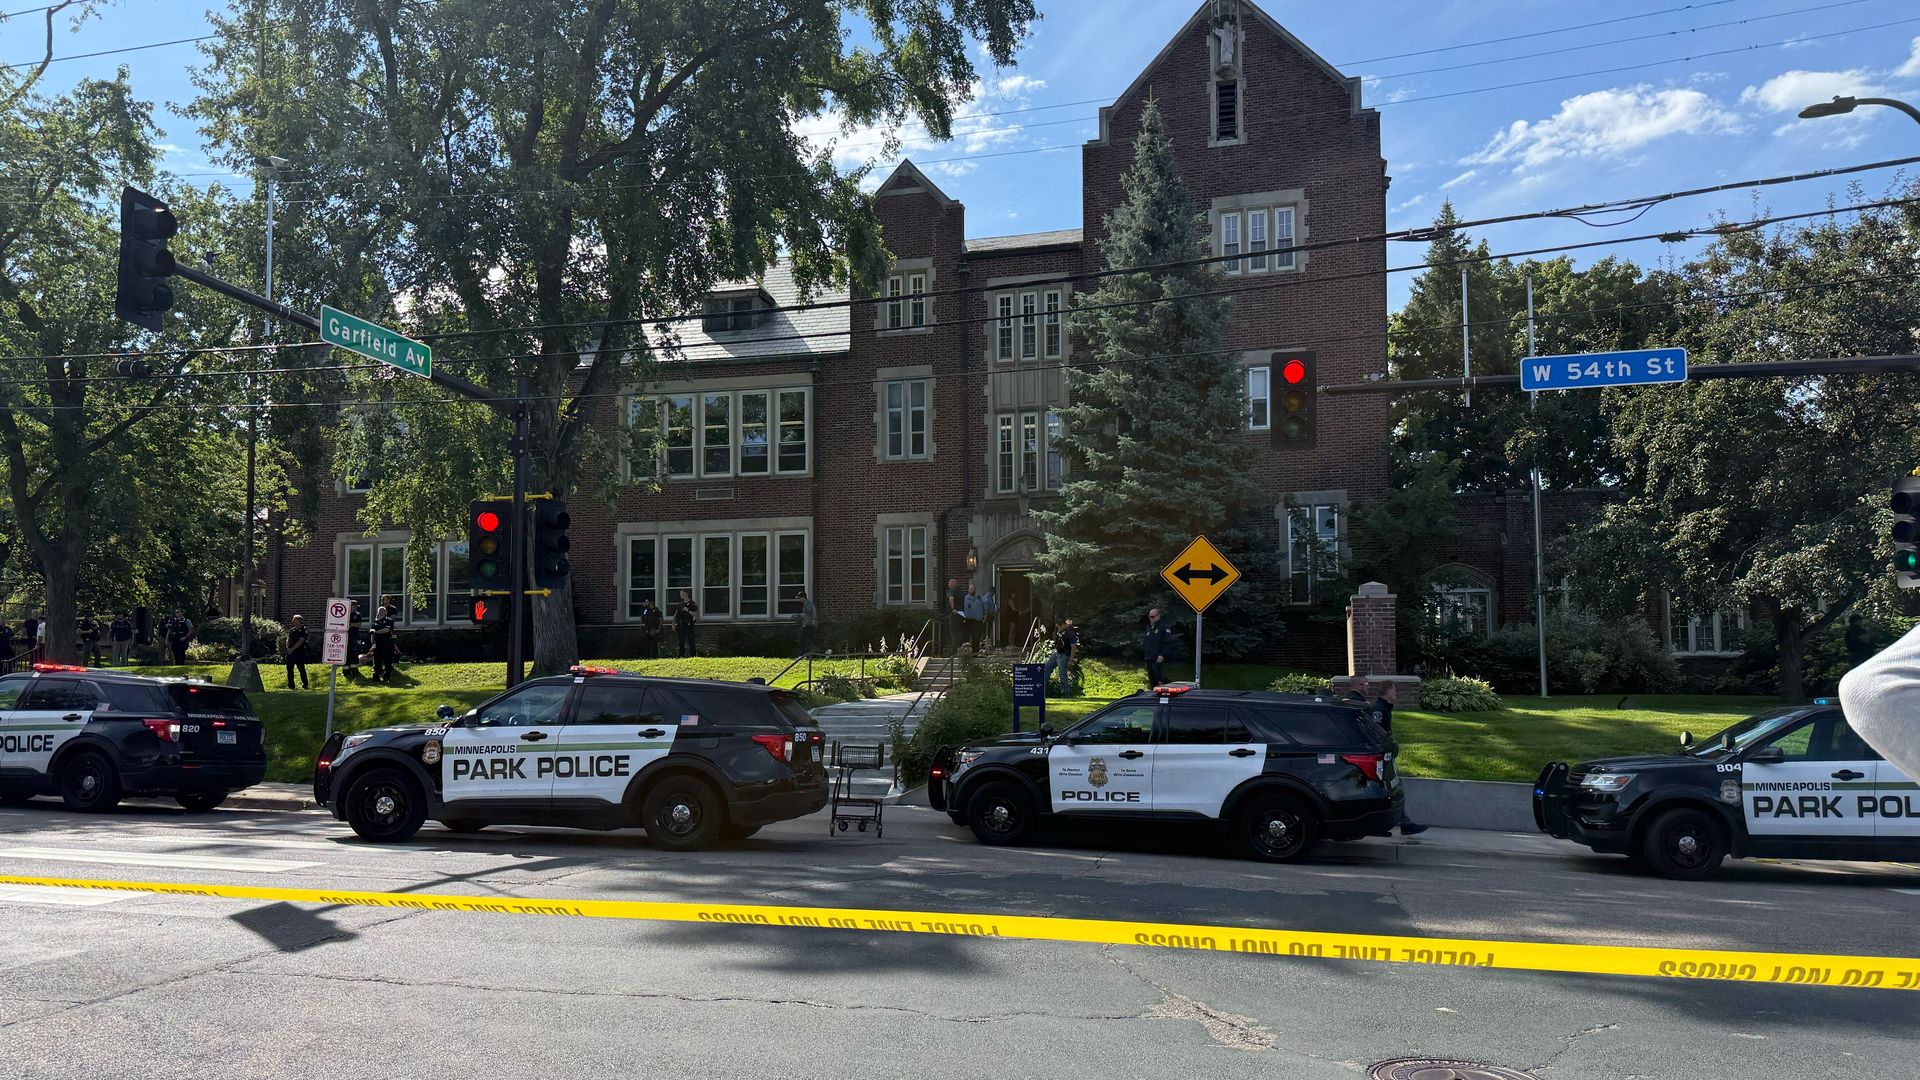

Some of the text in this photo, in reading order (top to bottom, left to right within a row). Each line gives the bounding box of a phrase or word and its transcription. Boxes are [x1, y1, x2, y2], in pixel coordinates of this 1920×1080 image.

[329, 317, 424, 368] Garfield Av
[1532, 357, 1675, 382] W 54th St
[182, 724, 200, 733] 820
[424, 728, 446, 736] 850
[794, 732, 807, 742] 850
[454, 745, 516, 755] MINNEAPOLIS
[1030, 747, 1049, 755] 431
[453, 755, 630, 781] PARK POLICE
[1716, 763, 1742, 773] 804
[1755, 782, 1831, 791] MINNEAPOLIS
[1061, 790, 1141, 803] POLICE
[1753, 796, 1843, 818] PARK
